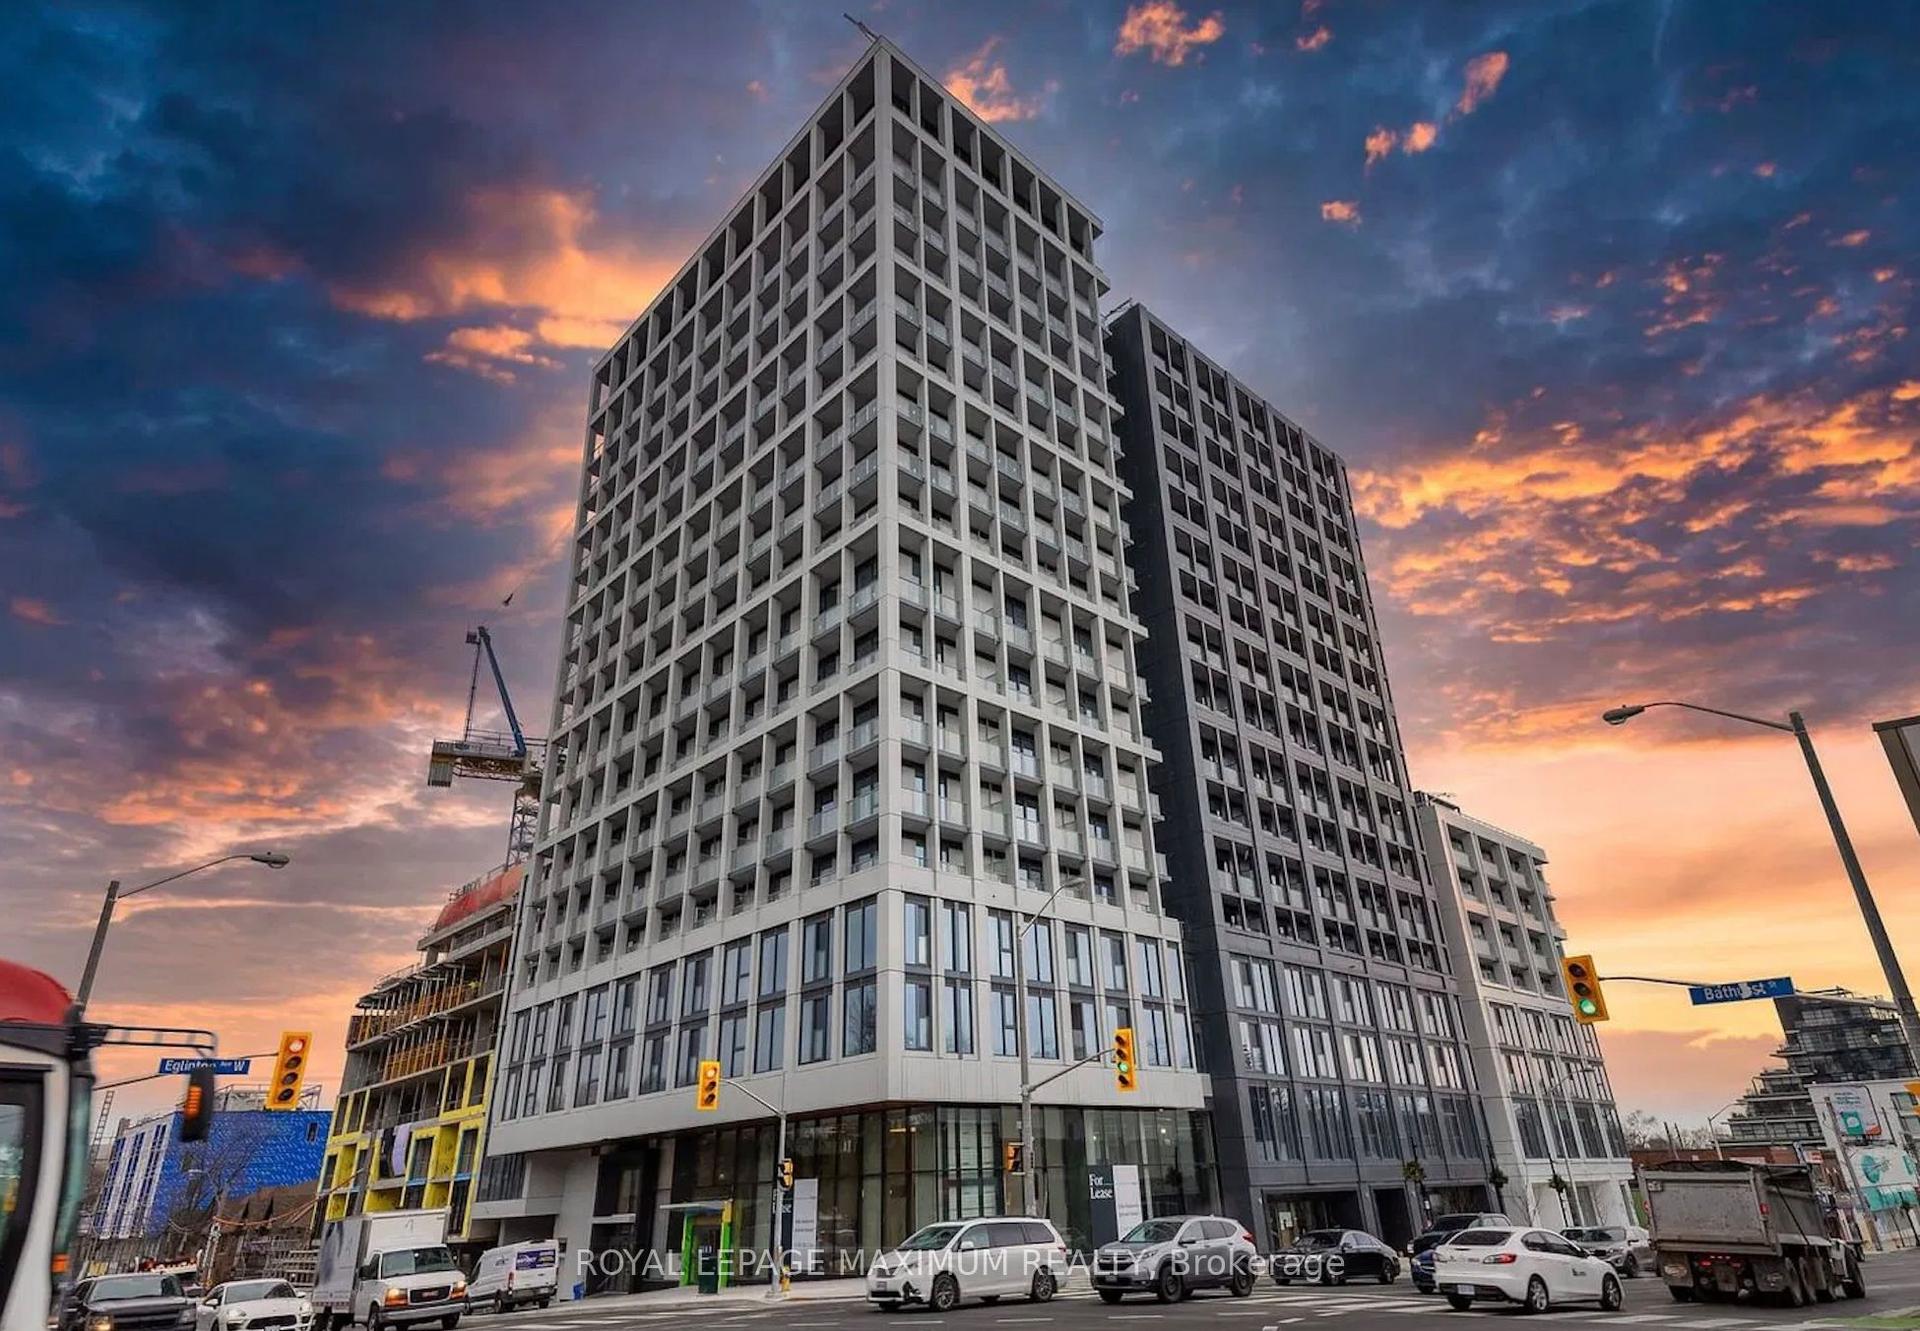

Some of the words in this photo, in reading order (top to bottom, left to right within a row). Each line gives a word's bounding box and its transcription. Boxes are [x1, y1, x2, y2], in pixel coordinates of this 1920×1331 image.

[233, 1060, 246, 1073] W
[1089, 1173, 1104, 1186] For
[1090, 1187, 1113, 1200] Lease
